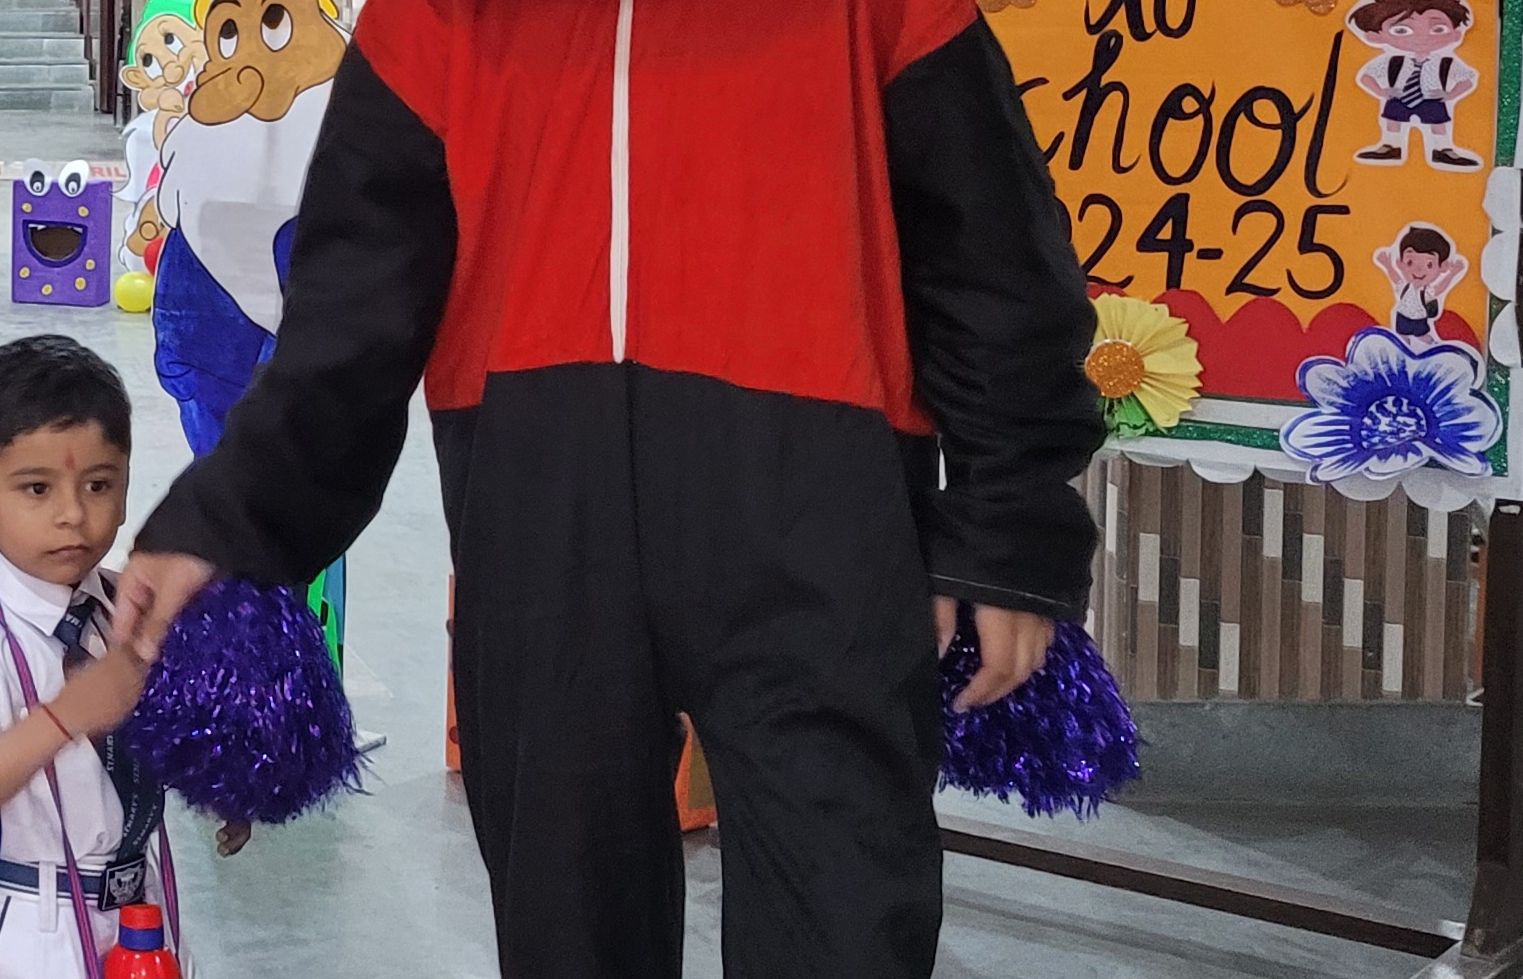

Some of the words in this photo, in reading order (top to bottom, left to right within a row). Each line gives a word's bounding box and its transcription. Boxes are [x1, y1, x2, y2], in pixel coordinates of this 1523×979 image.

[1016, 28, 1350, 198] hool
[91, 166, 128, 178] RIL
[1055, 192, 1351, 301] 24-25
